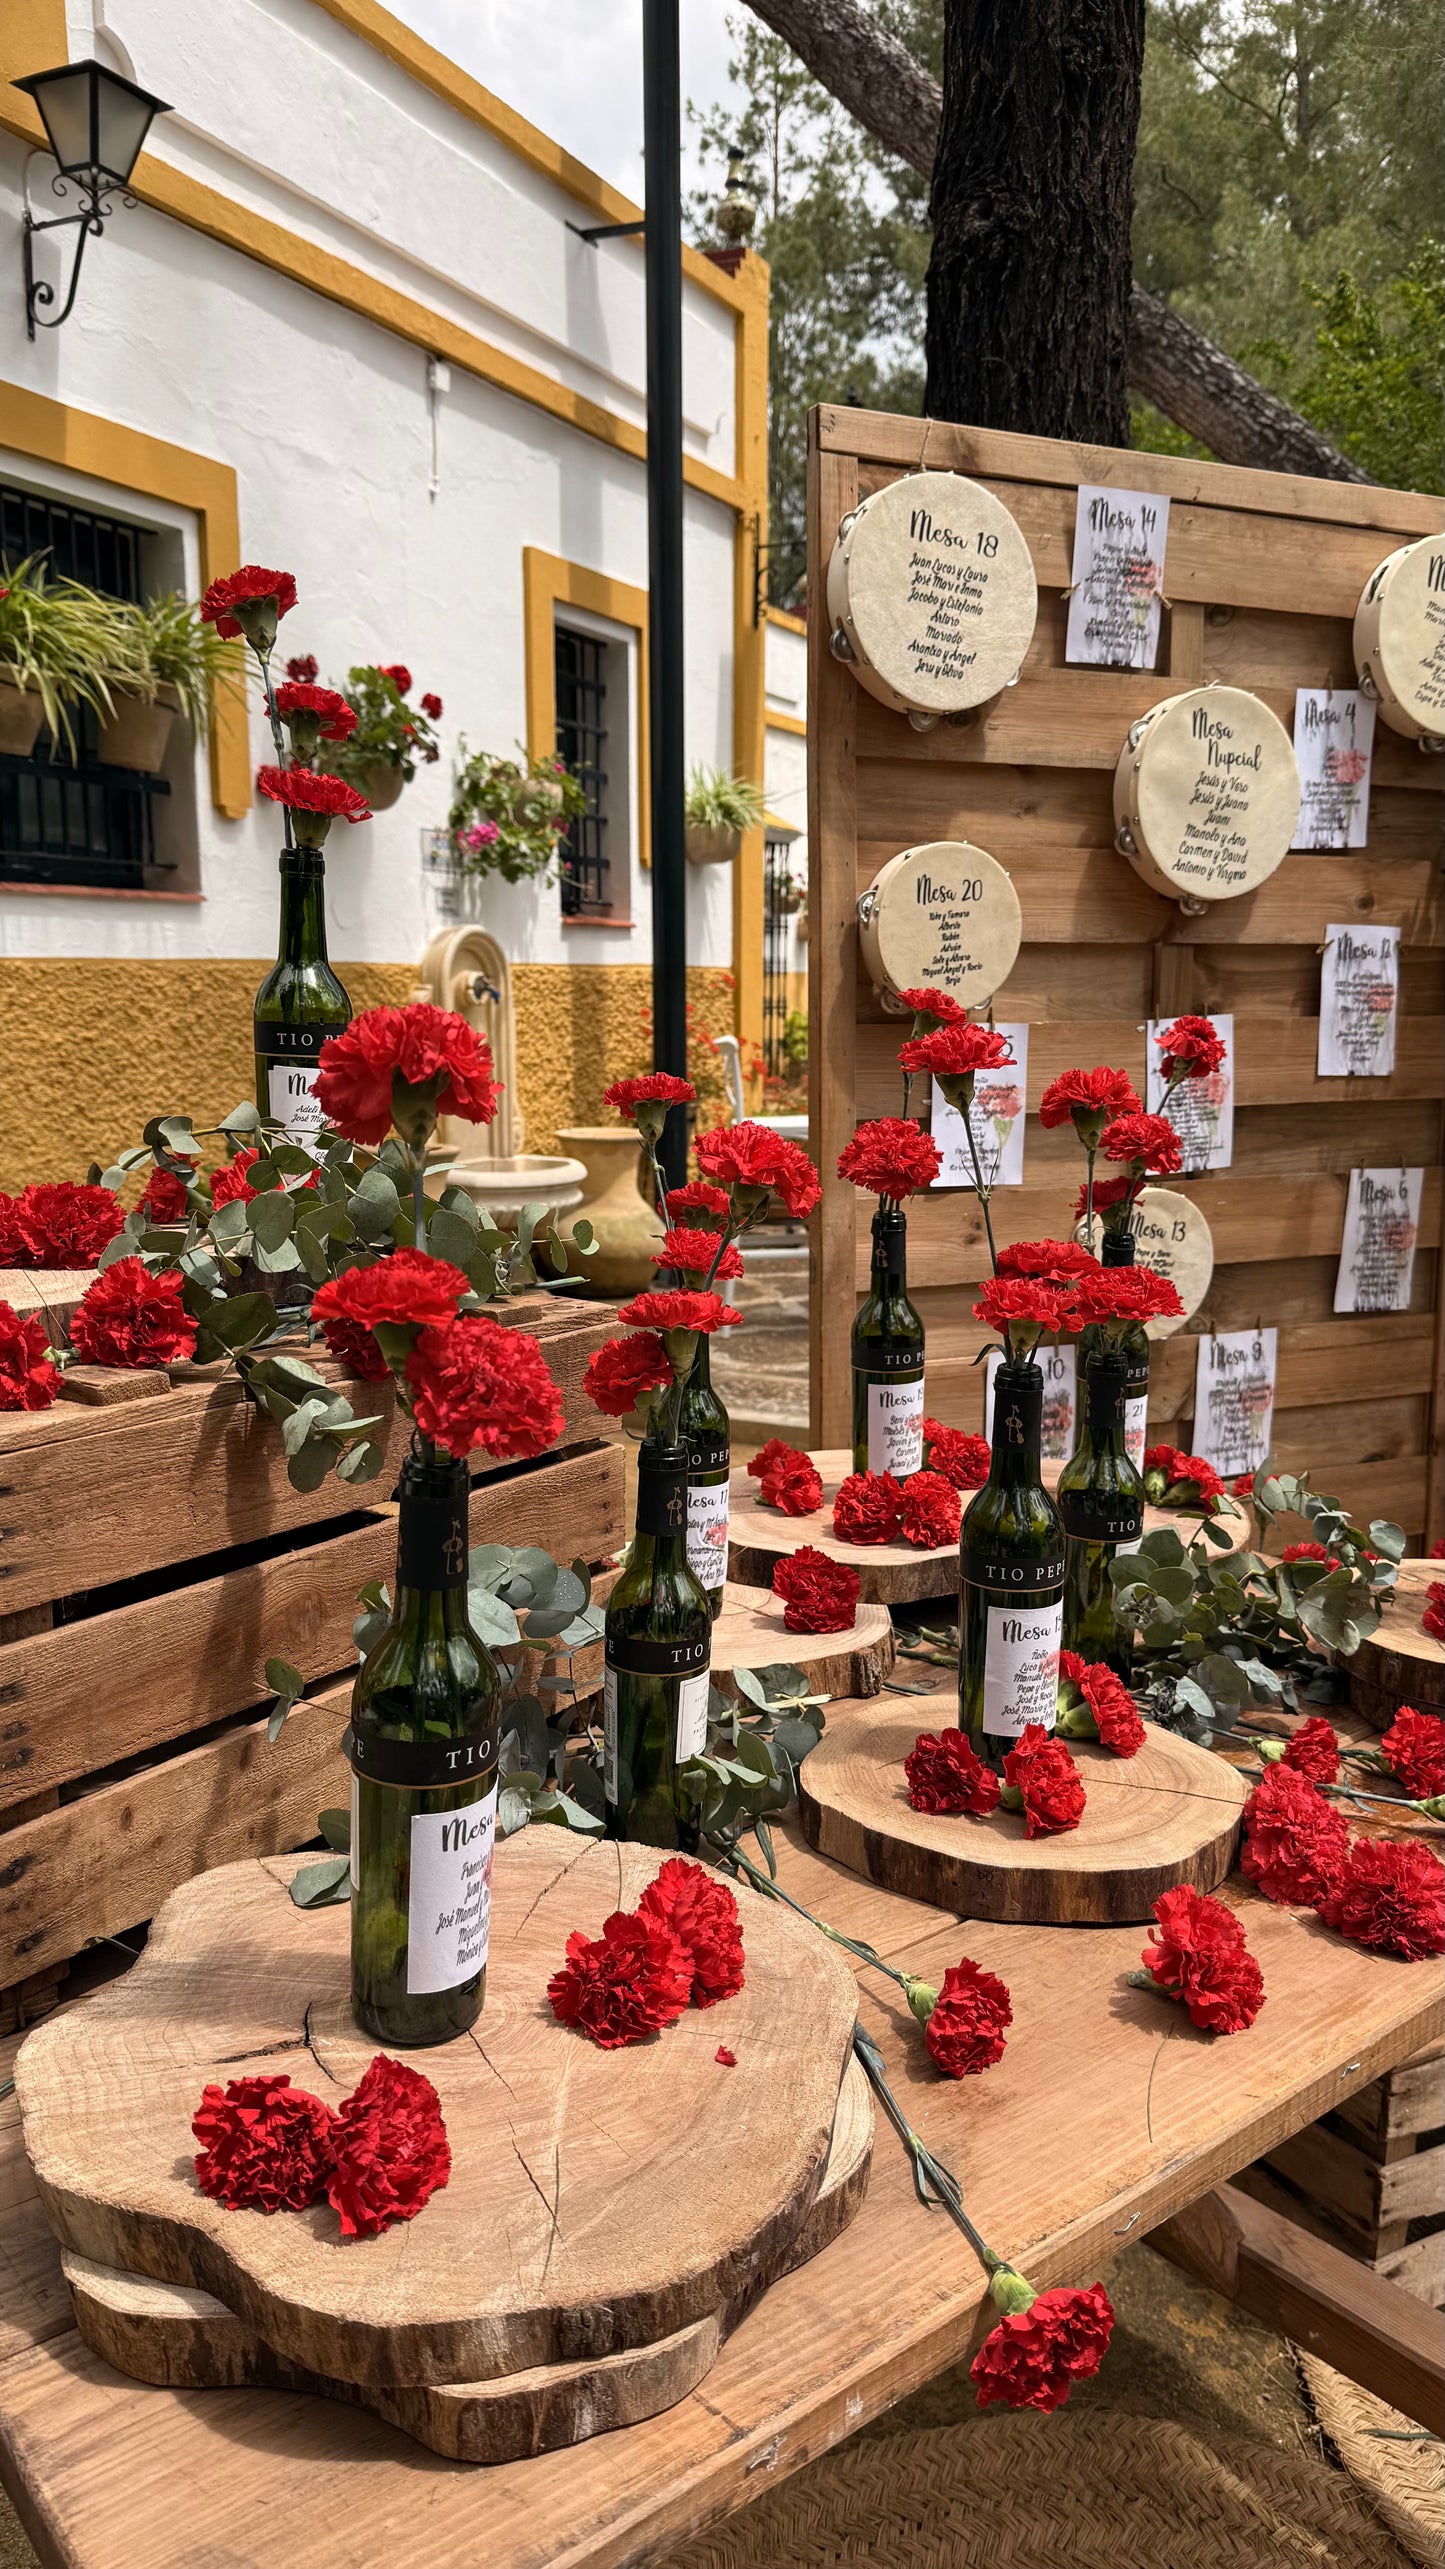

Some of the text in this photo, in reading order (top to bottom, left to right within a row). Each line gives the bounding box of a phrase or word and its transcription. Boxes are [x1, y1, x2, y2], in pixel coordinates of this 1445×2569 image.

[1090, 497, 1156, 533] Mesa 14
[910, 509, 999, 558] Mesa 18
[909, 552, 988, 582] Juan Lucas y Laura
[911, 570, 983, 598] José Mari e Inma
[907, 587, 983, 615] Jacobo y Estefanía
[907, 639, 977, 667] Arantxa y Ángel
[934, 665, 941, 679] y
[1193, 707, 1233, 740] Mesa
[1304, 698, 1356, 728] Mesa 4
[1208, 738, 1262, 774] Nupcial
[1195, 771, 1248, 793] Jesús y Vero
[1189, 788, 1249, 811] Jesús y Juana
[1203, 809, 1231, 826] Juani
[1184, 823, 1247, 848] Manolo y Ana
[1178, 840, 1249, 864] Carmen y David
[1171, 858, 1247, 885] Antonio y Virginia
[917, 874, 983, 905] Mesa 20
[947, 910, 970, 919] Tamara
[941, 932, 960, 941] Rubén
[1337, 931, 1377, 961] Mesa
[922, 965, 944, 978] Miguel
[277, 1032, 313, 1047] TIO
[290, 1114, 310, 1123] José
[1360, 1177, 1408, 1203] Mesa 6
[1129, 1212, 1186, 1242] Mesa 13
[885, 1350, 925, 1365] TIO PE
[1210, 1341, 1248, 1370] Mesa
[1047, 1356, 1065, 1380] 10
[879, 1390, 915, 1409] Mesa
[1132, 1403, 1143, 1418] 21
[710, 1449, 730, 1464] PEP
[1107, 1519, 1136, 1533] TIO
[986, 1559, 1065, 1582] TIO PEPE
[1003, 1619, 1051, 1644] Mesa
[671, 1643, 704, 1663] TIO
[1013, 1672, 1043, 1682] Manuel
[1015, 1694, 1034, 1706] José
[1033, 1695, 1039, 1705] y
[1017, 1684, 1035, 1695] Pepe
[1035, 1684, 1040, 1695] y
[1000, 1705, 1020, 1716] José
[446, 1739, 490, 1770] TIO
[442, 1813, 493, 1853] Mesa
[435, 1908, 456, 1935] José
[455, 1900, 480, 1926] Manuel
